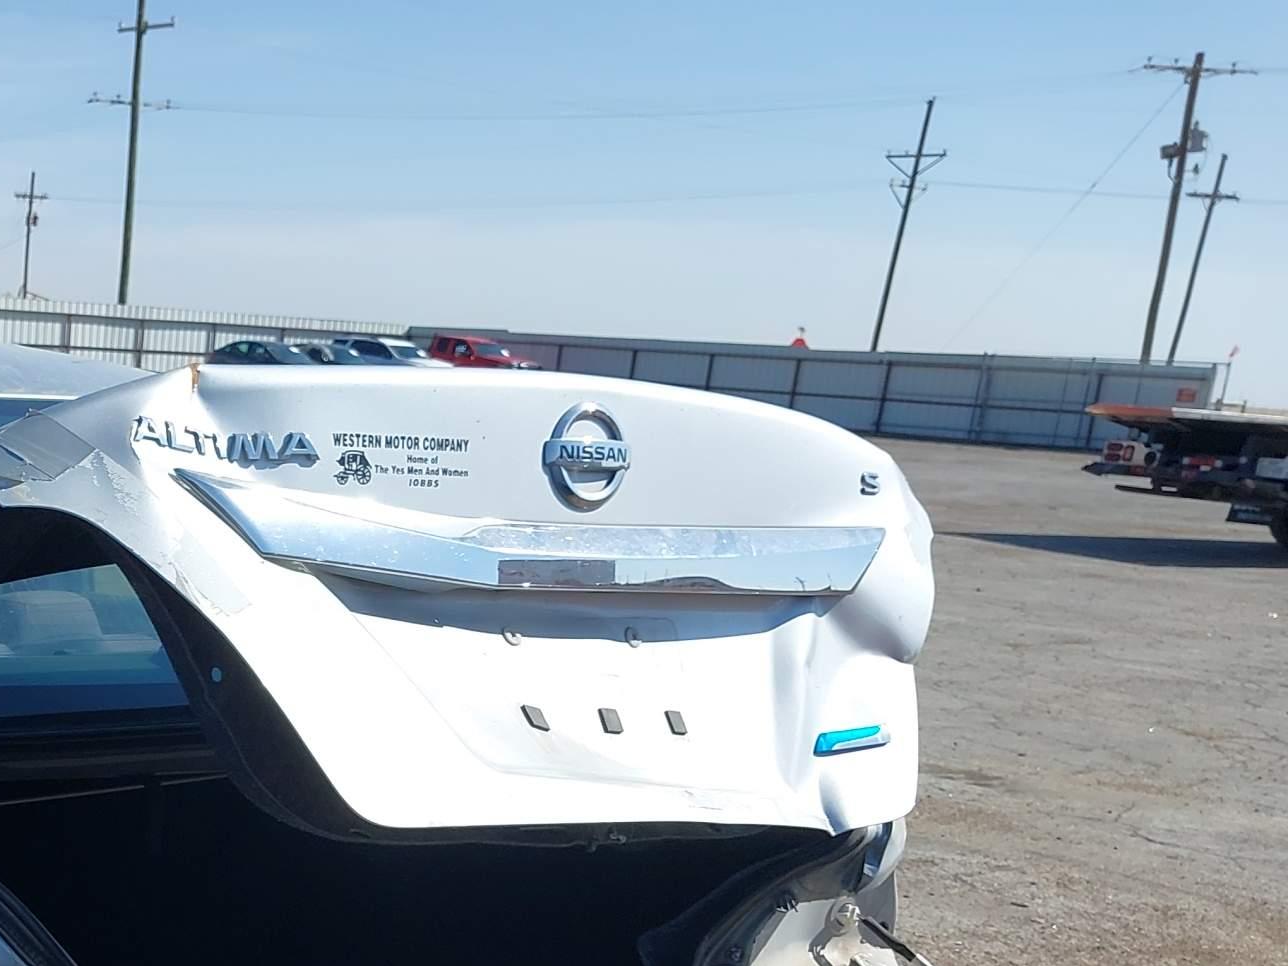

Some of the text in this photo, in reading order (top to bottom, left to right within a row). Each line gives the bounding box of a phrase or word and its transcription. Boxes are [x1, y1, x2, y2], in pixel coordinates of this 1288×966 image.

[130, 416, 318, 469] ALTIMA
[332, 433, 469, 452] WESTERN MOTOR COMPANY
[407, 455, 438, 464] Home of
[560, 445, 627, 464] NISSAN
[375, 465, 469, 477] The Yes Men And Women
[860, 472, 881, 496] S
